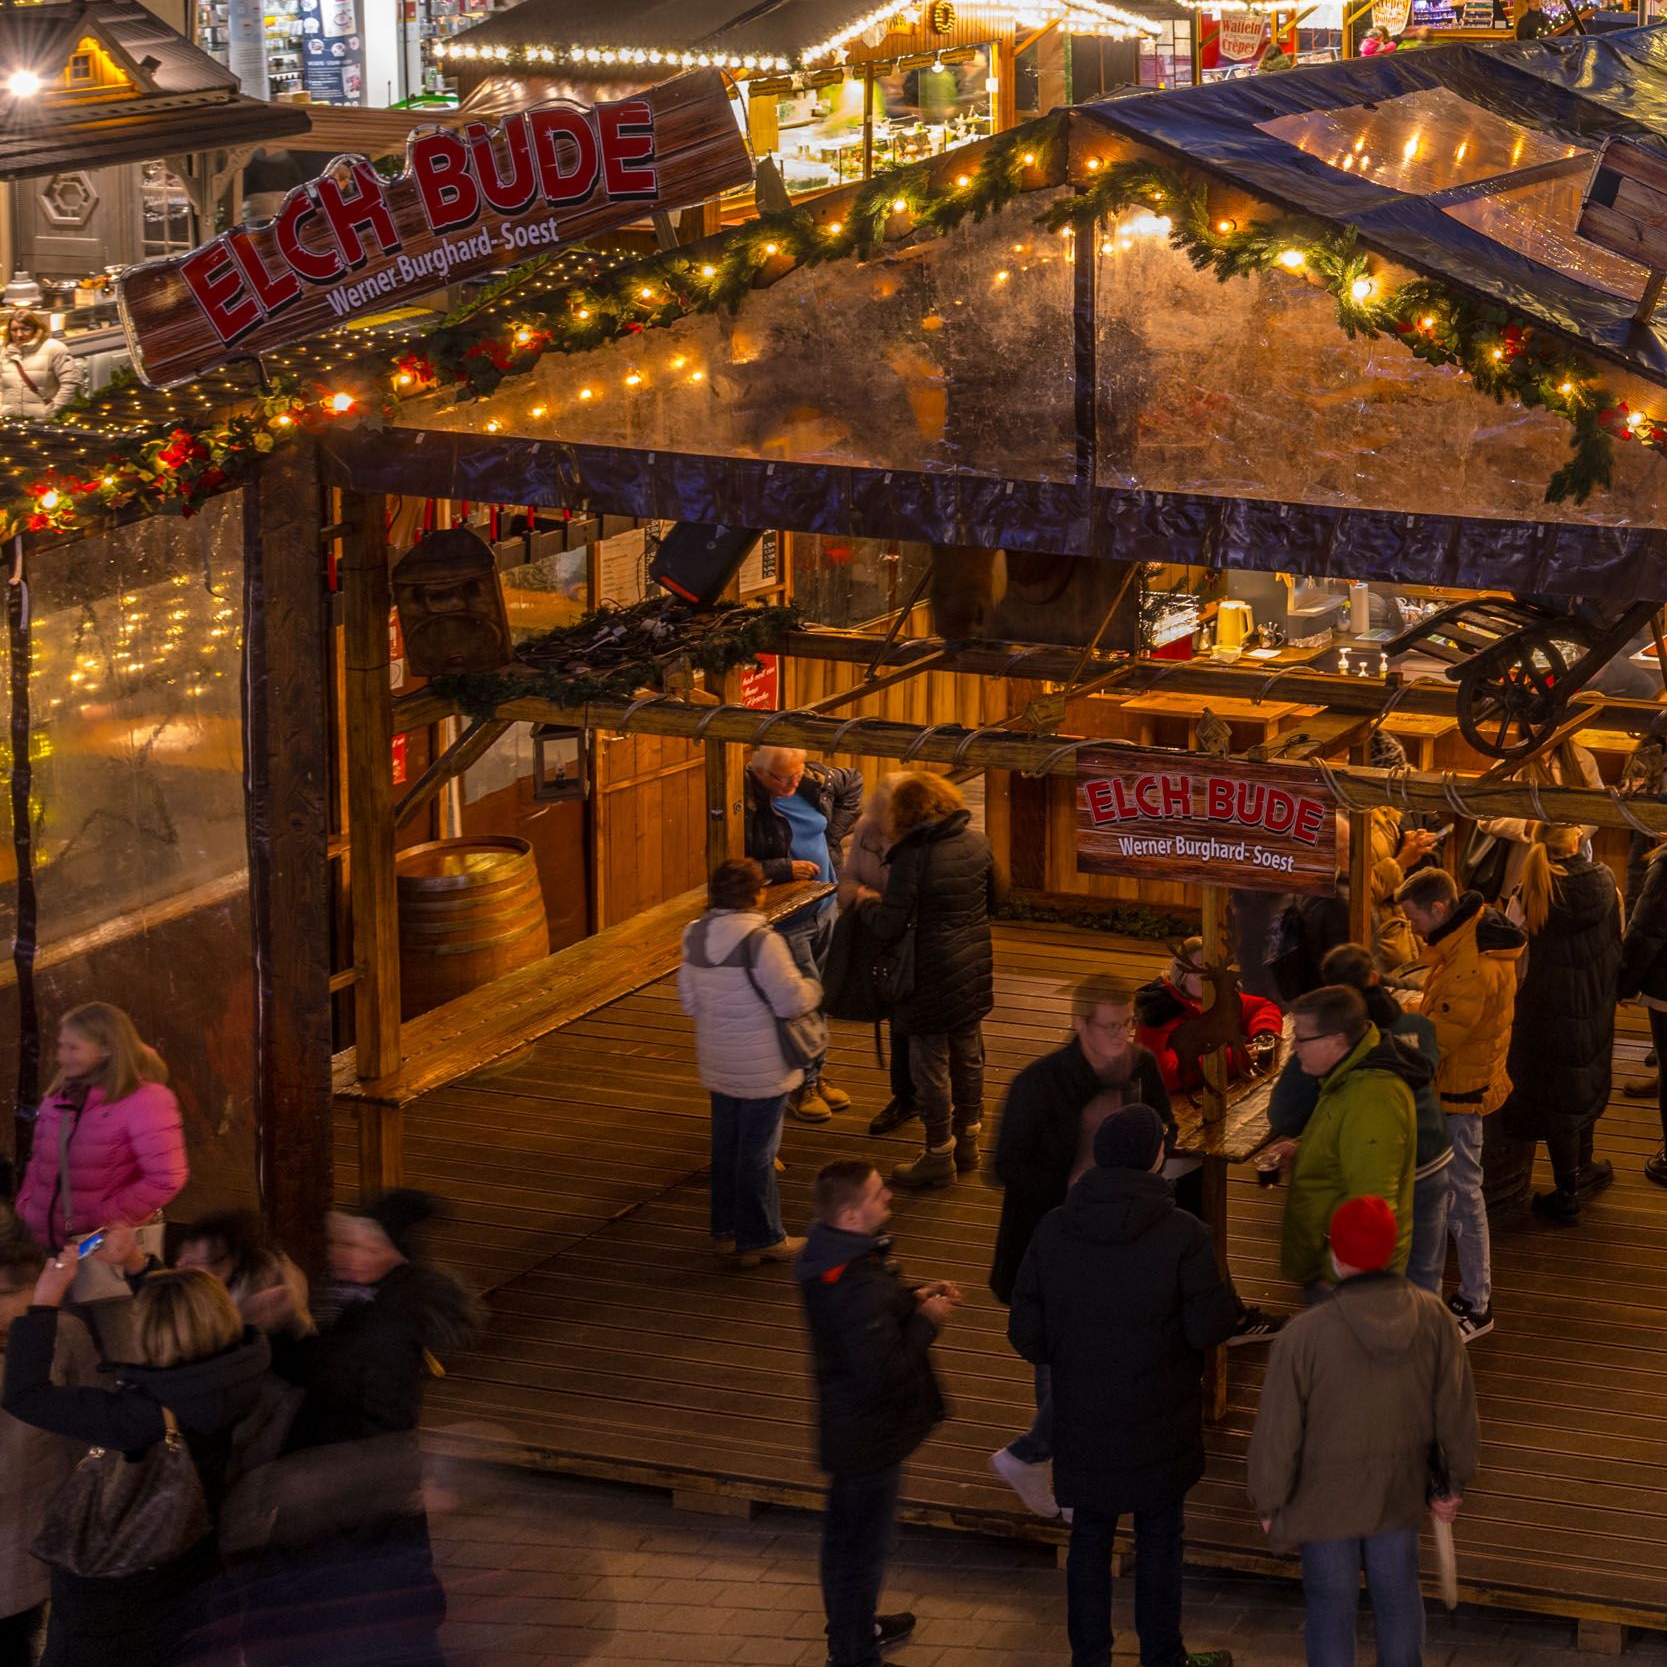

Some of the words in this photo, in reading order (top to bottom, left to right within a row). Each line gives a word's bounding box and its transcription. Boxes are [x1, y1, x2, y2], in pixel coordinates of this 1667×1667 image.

[180, 159, 402, 348] ELCH
[411, 100, 660, 232] BUDE
[326, 268, 400, 317] Werner
[501, 216, 560, 253] Soest
[1085, 774, 1193, 826] ELCH
[1206, 777, 1325, 846] BUDE
[1118, 836, 1172, 857] Werner
[1175, 835, 1249, 863] Burghard-
[1252, 845, 1295, 873] Soest
